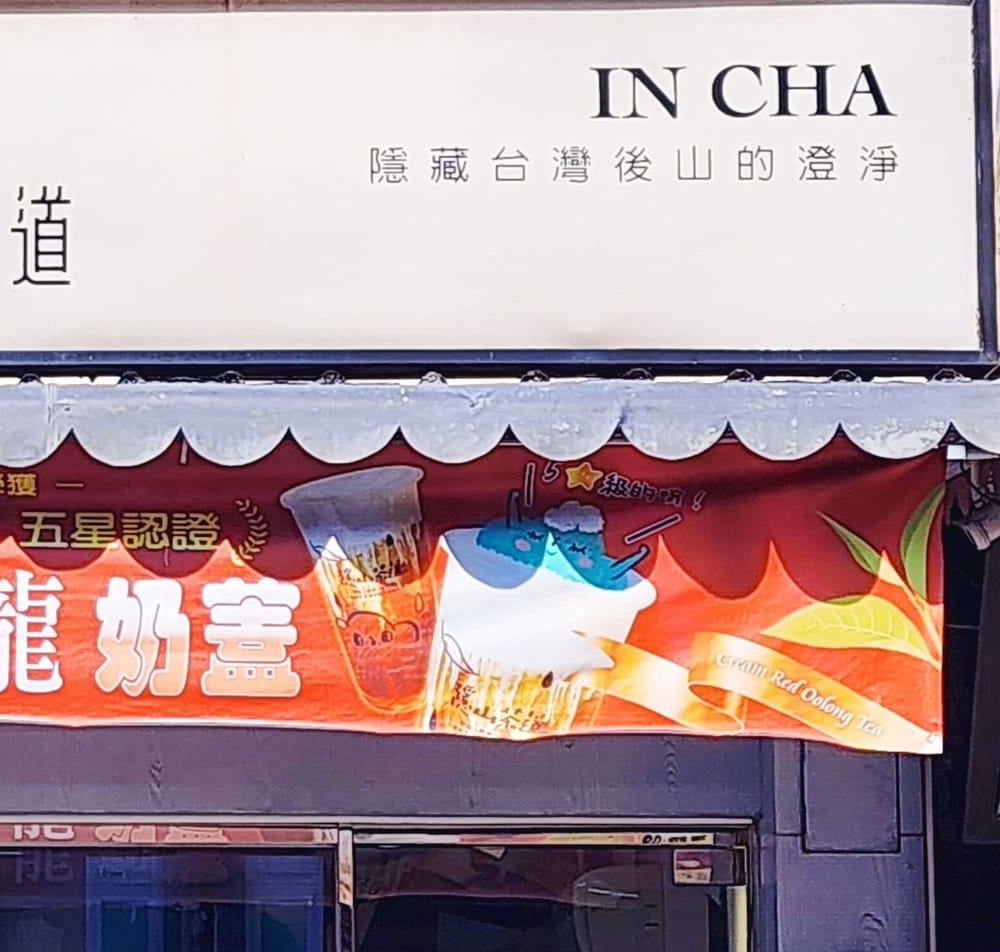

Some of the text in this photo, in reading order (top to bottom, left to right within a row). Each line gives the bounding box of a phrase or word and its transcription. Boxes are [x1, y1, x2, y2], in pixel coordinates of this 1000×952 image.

[589, 63, 898, 119] IN CHA
[368, 145, 900, 184] 隱藏台灣後山的澄淨
[21, 510, 222, 552] 五星認證
[716, 652, 884, 737] Cream Red Oolong Tea
